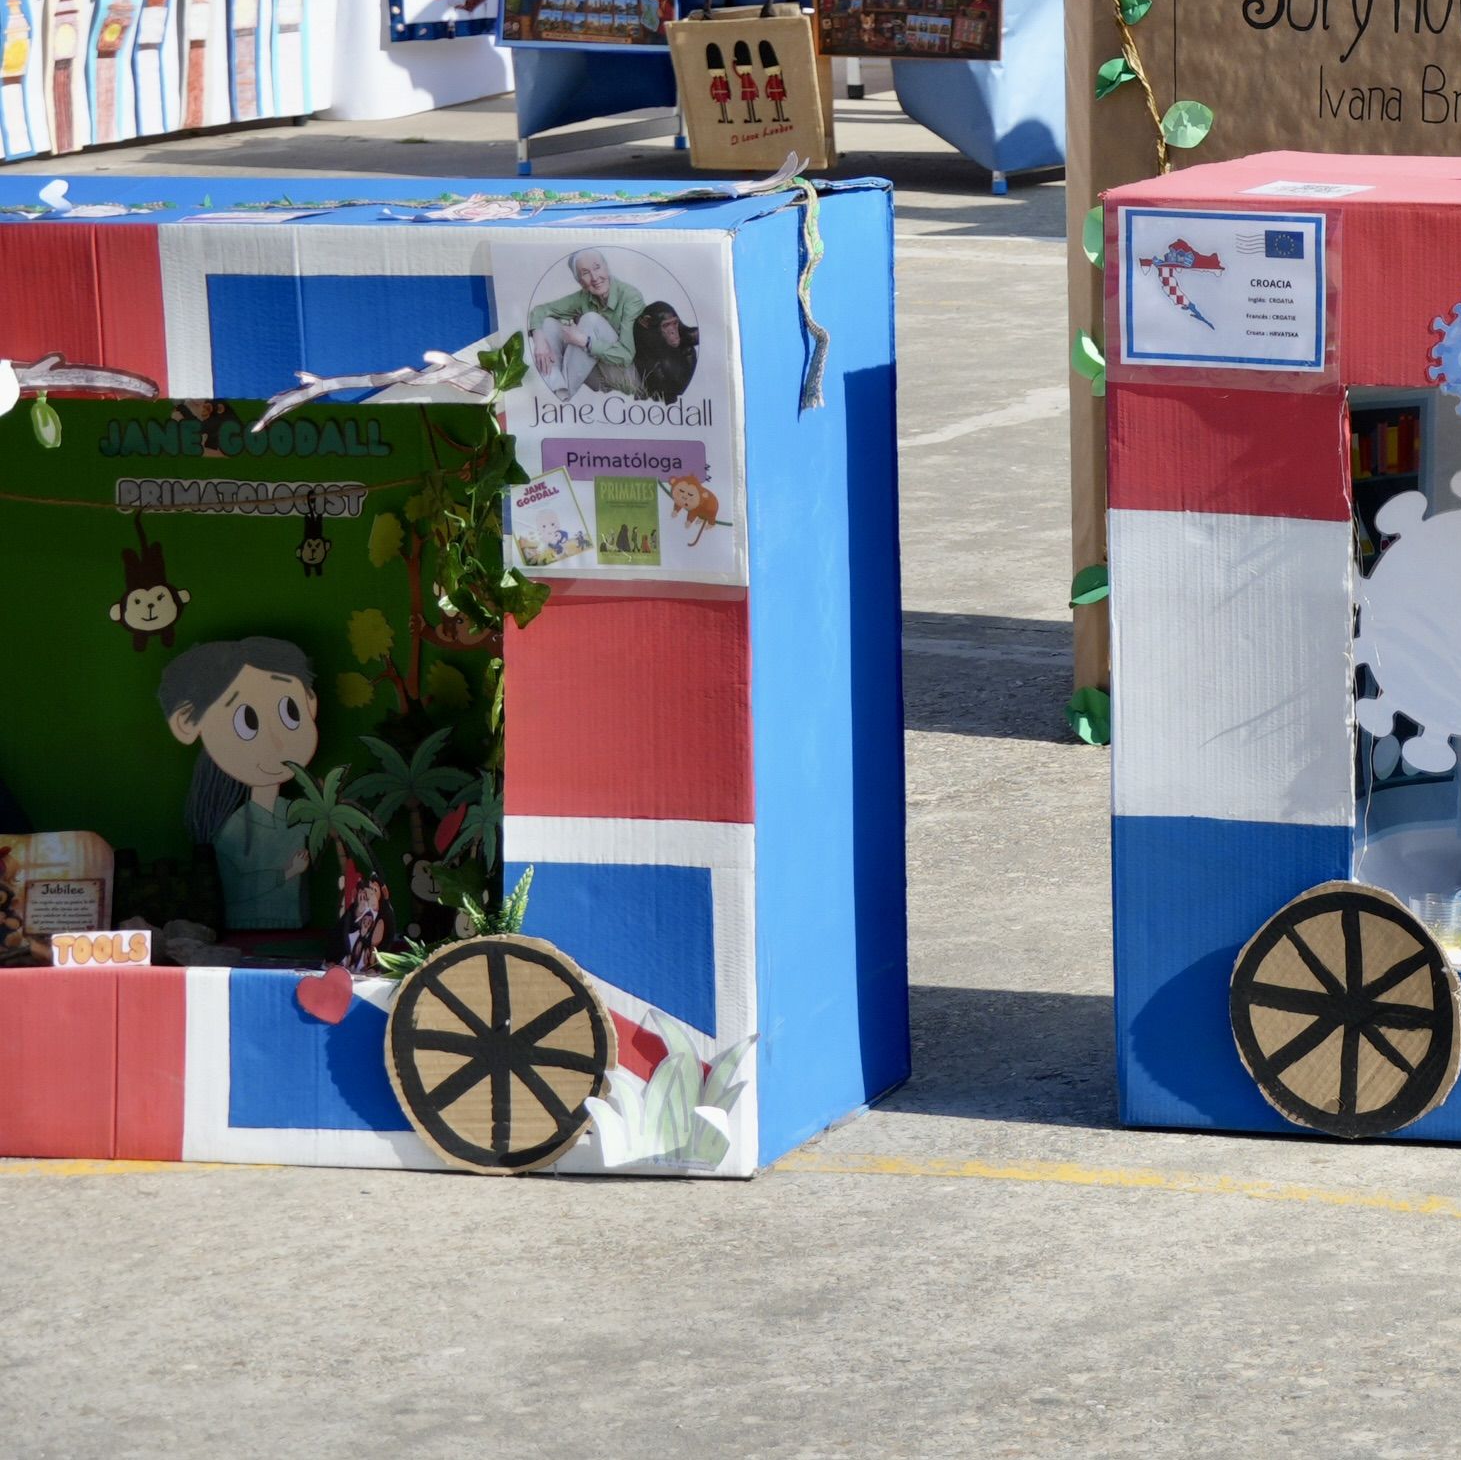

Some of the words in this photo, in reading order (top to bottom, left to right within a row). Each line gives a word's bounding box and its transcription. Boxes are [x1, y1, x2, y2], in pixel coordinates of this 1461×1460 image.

[1318, 64, 1402, 123] Ivana
[1250, 279, 1292, 289] CROACIA
[529, 395, 594, 428] Jane
[602, 395, 713, 427] Goodall
[100, 417, 204, 458] JANE
[217, 417, 393, 458] GOODALL
[566, 451, 683, 473] Primatóloga
[117, 479, 368, 517] PRIMATOLOGIST
[516, 486, 560, 508] GOODALL
[523, 481, 548, 497] JANE
[599, 482, 656, 501] PRIMATES
[41, 883, 86, 895] Jubilee
[52, 932, 149, 966] TOOLS
